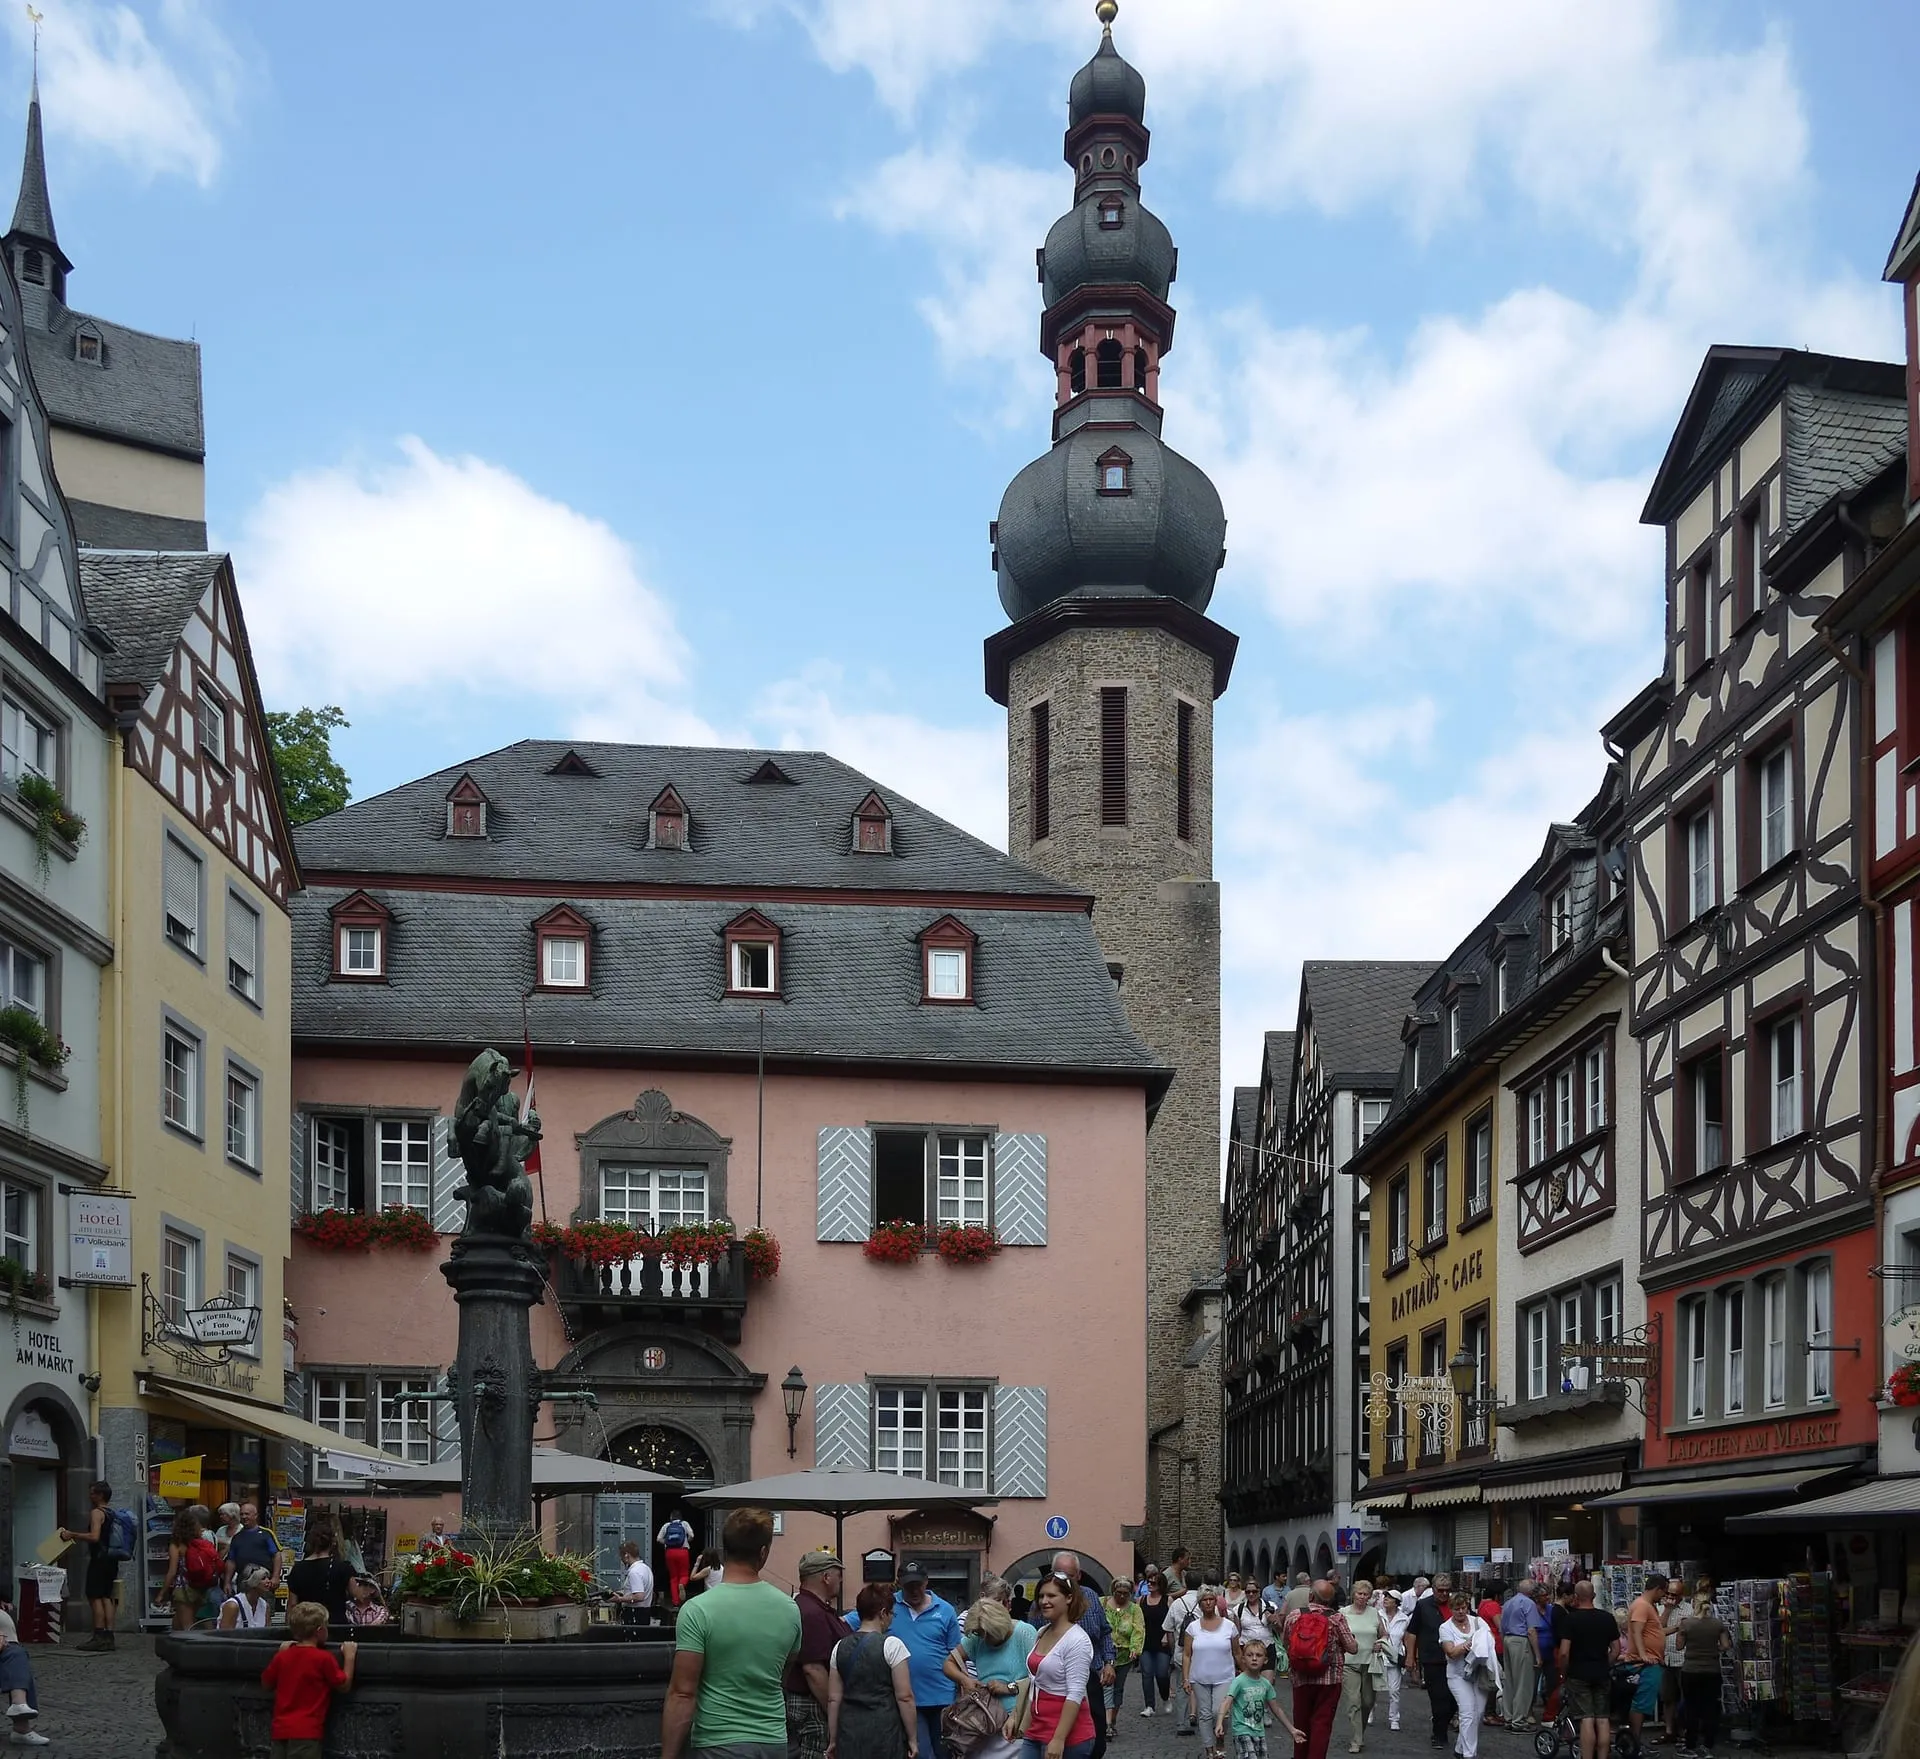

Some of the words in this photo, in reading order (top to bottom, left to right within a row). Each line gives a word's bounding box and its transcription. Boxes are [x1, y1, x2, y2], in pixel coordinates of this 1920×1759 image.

[87, 1238, 126, 1248] Volksbank
[75, 1270, 127, 1281] Geldautomat
[1391, 1273, 1440, 1322] RATHAUS
[196, 1311, 246, 1327] Reformhaus
[213, 1321, 230, 1329] Foto
[202, 1329, 242, 1337] Toto-Lotto
[28, 1330, 62, 1353] HOTEL
[16, 1347, 33, 1366] AM
[37, 1352, 73, 1374] MARKT
[615, 1391, 694, 1403] RATHAUS
[14, 1434, 48, 1447] Geldautomat
[1667, 1434, 1742, 1462] LÄDCHEN
[1744, 1431, 1768, 1452] AM
[1773, 1421, 1841, 1450] MARKT
